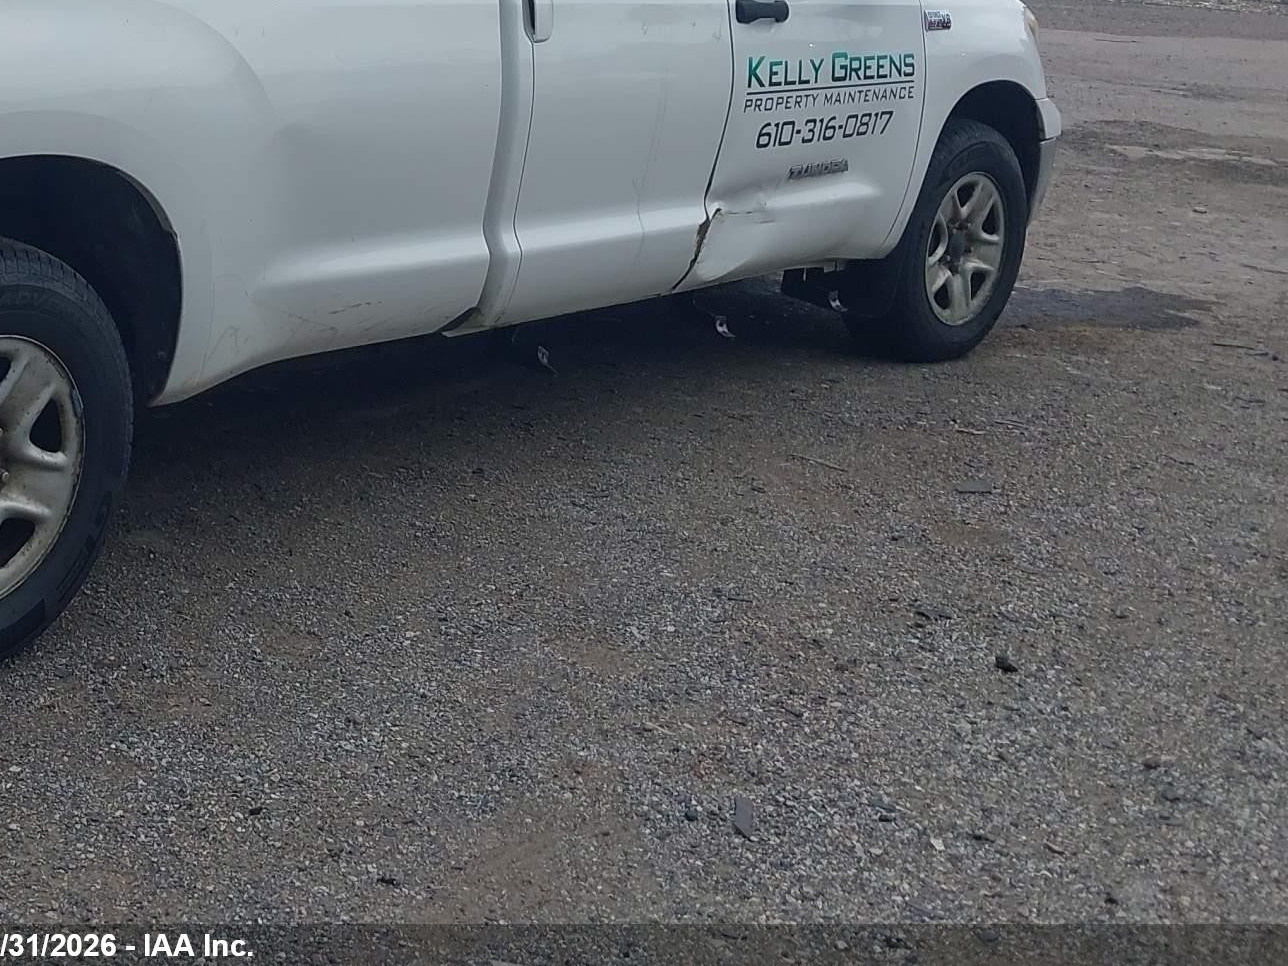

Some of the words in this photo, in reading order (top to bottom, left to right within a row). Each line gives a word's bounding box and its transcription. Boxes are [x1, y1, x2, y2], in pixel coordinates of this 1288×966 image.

[744, 94, 819, 113] PROPERTY
[824, 86, 915, 107] MAINTENANCE
[755, 111, 893, 149] 610-316-0817
